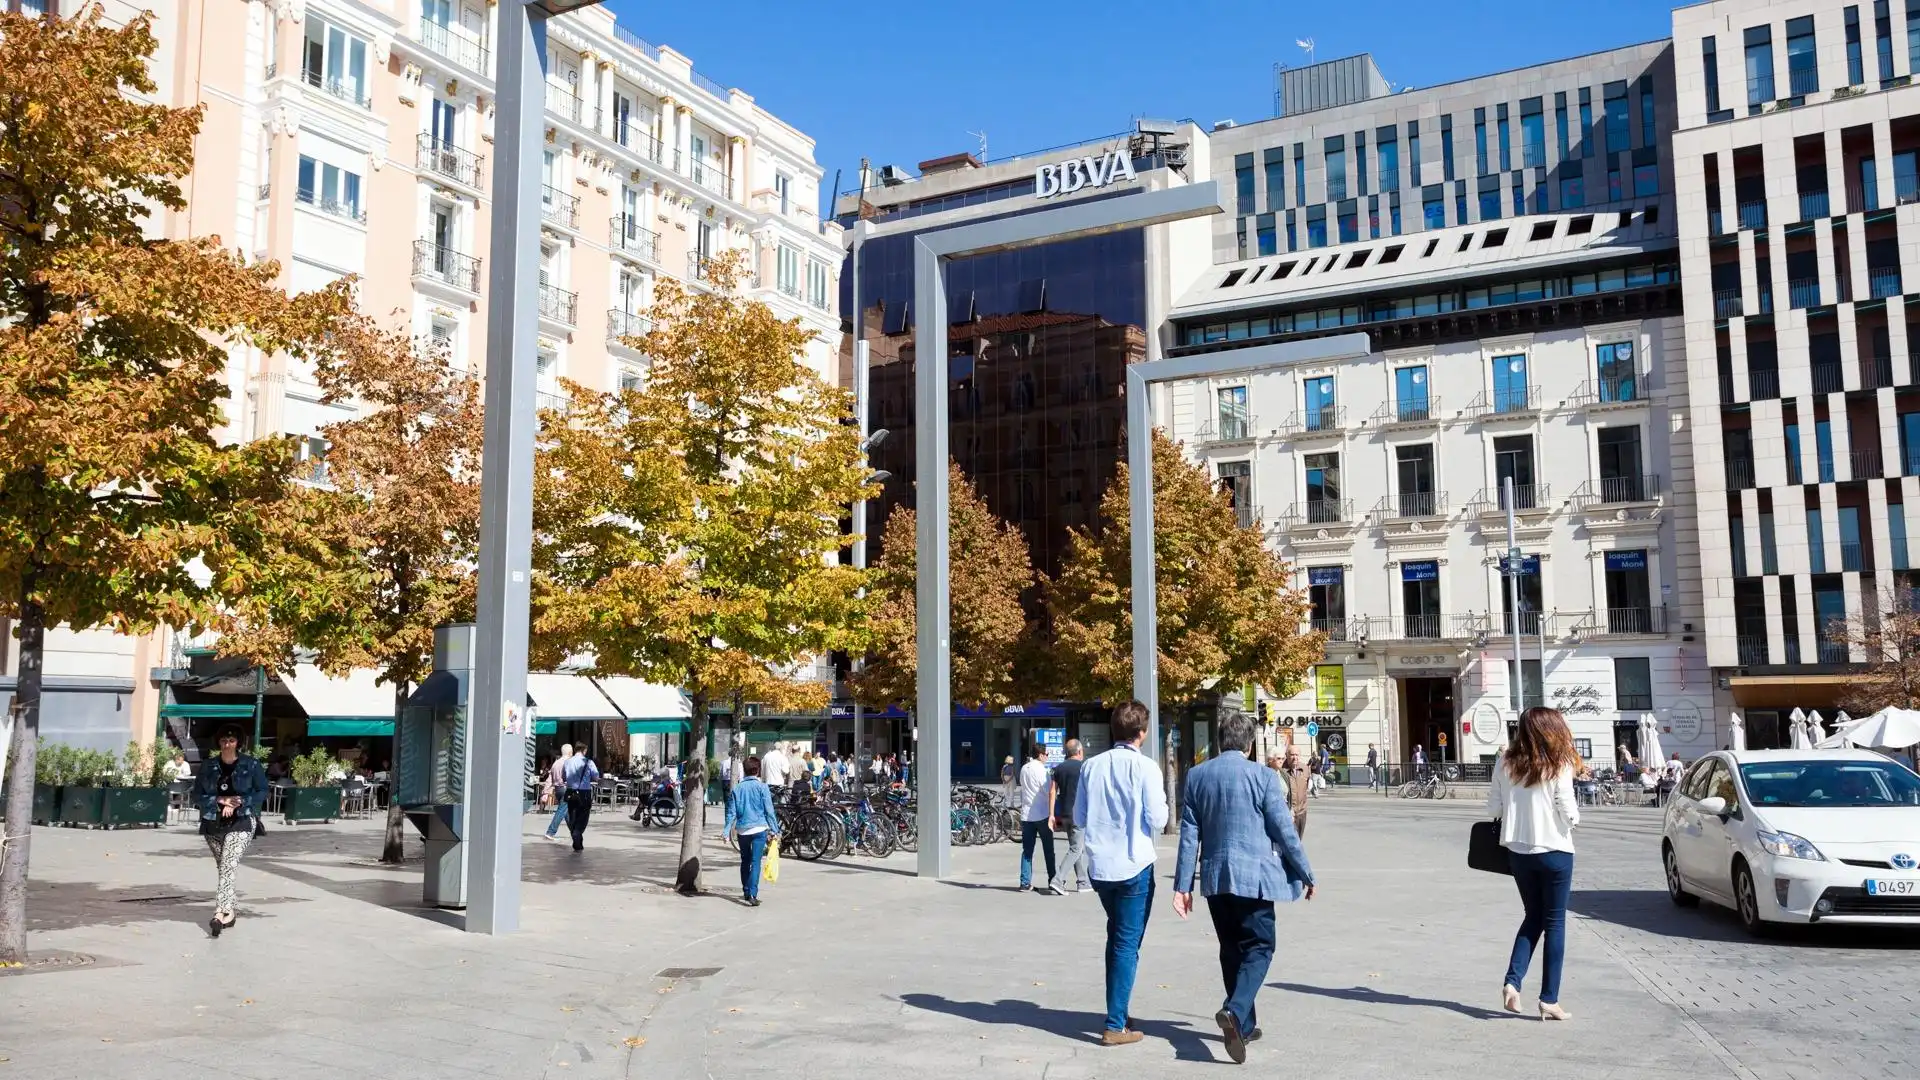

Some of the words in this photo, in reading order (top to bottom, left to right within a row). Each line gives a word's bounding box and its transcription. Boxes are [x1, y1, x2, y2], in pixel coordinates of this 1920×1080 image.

[1036, 150, 1137, 199] BBVA
[831, 707, 850, 715] BBV
[1004, 704, 1025, 713] BBVA
[1278, 716, 1294, 726] LO
[1298, 714, 1342, 726] BUENO
[1878, 881, 1914, 893] 0497
